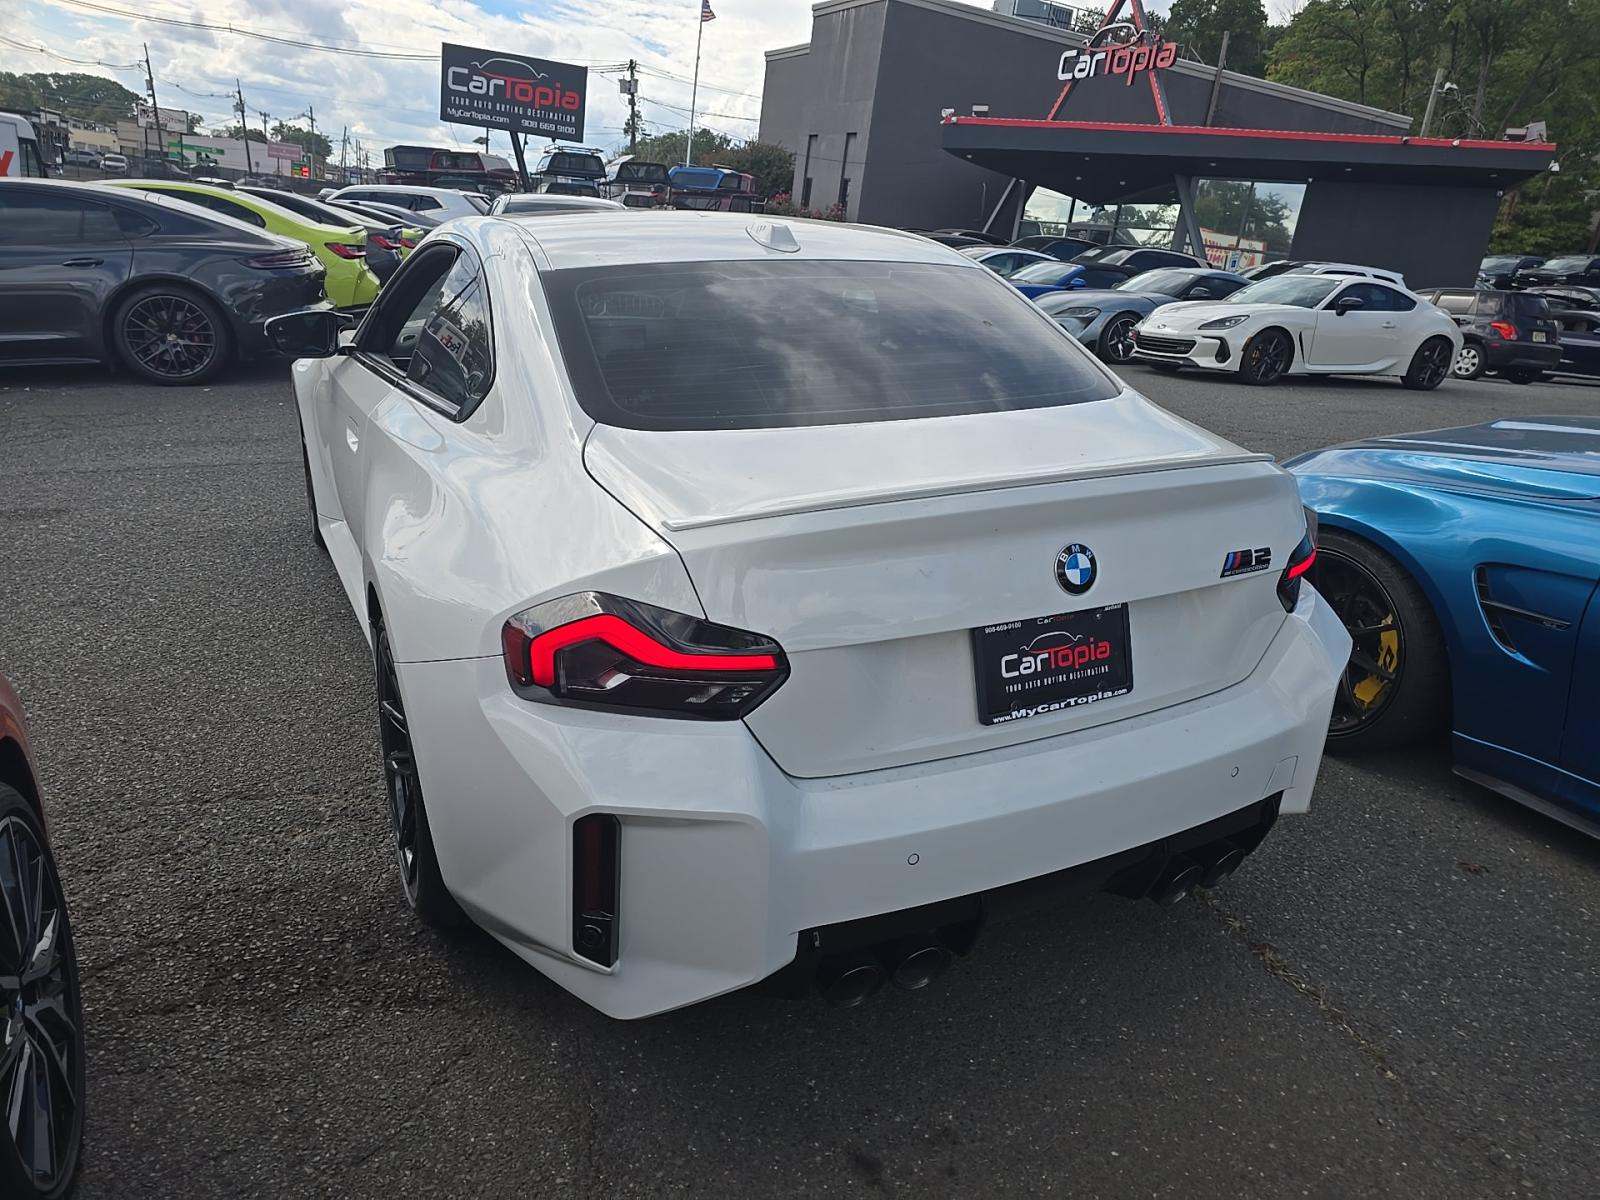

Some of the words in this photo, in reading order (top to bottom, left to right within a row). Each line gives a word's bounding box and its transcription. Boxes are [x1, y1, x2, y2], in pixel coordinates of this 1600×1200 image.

[1057, 34, 1177, 86] CarTopia
[447, 66, 581, 111] CarTopia
[447, 107, 510, 123] MyCarTopia.com
[451, 96, 469, 106] YOUR
[474, 99, 492, 110] AUTO
[496, 102, 523, 115] BUYING
[527, 108, 575, 123] DESTINATION
[521, 119, 538, 128] 908
[539, 122, 555, 131] 669
[556, 124, 576, 135] 9100
[1060, 543, 1094, 562] BMW
[1001, 636, 1111, 679] CarTopia
[1005, 683, 1022, 693] YOUR
[1025, 679, 1041, 690] AUTO
[1044, 674, 1067, 686] BUYING
[1069, 664, 1109, 680] DESTINATION
[993, 688, 1127, 723] www.MyCarTopia.com
